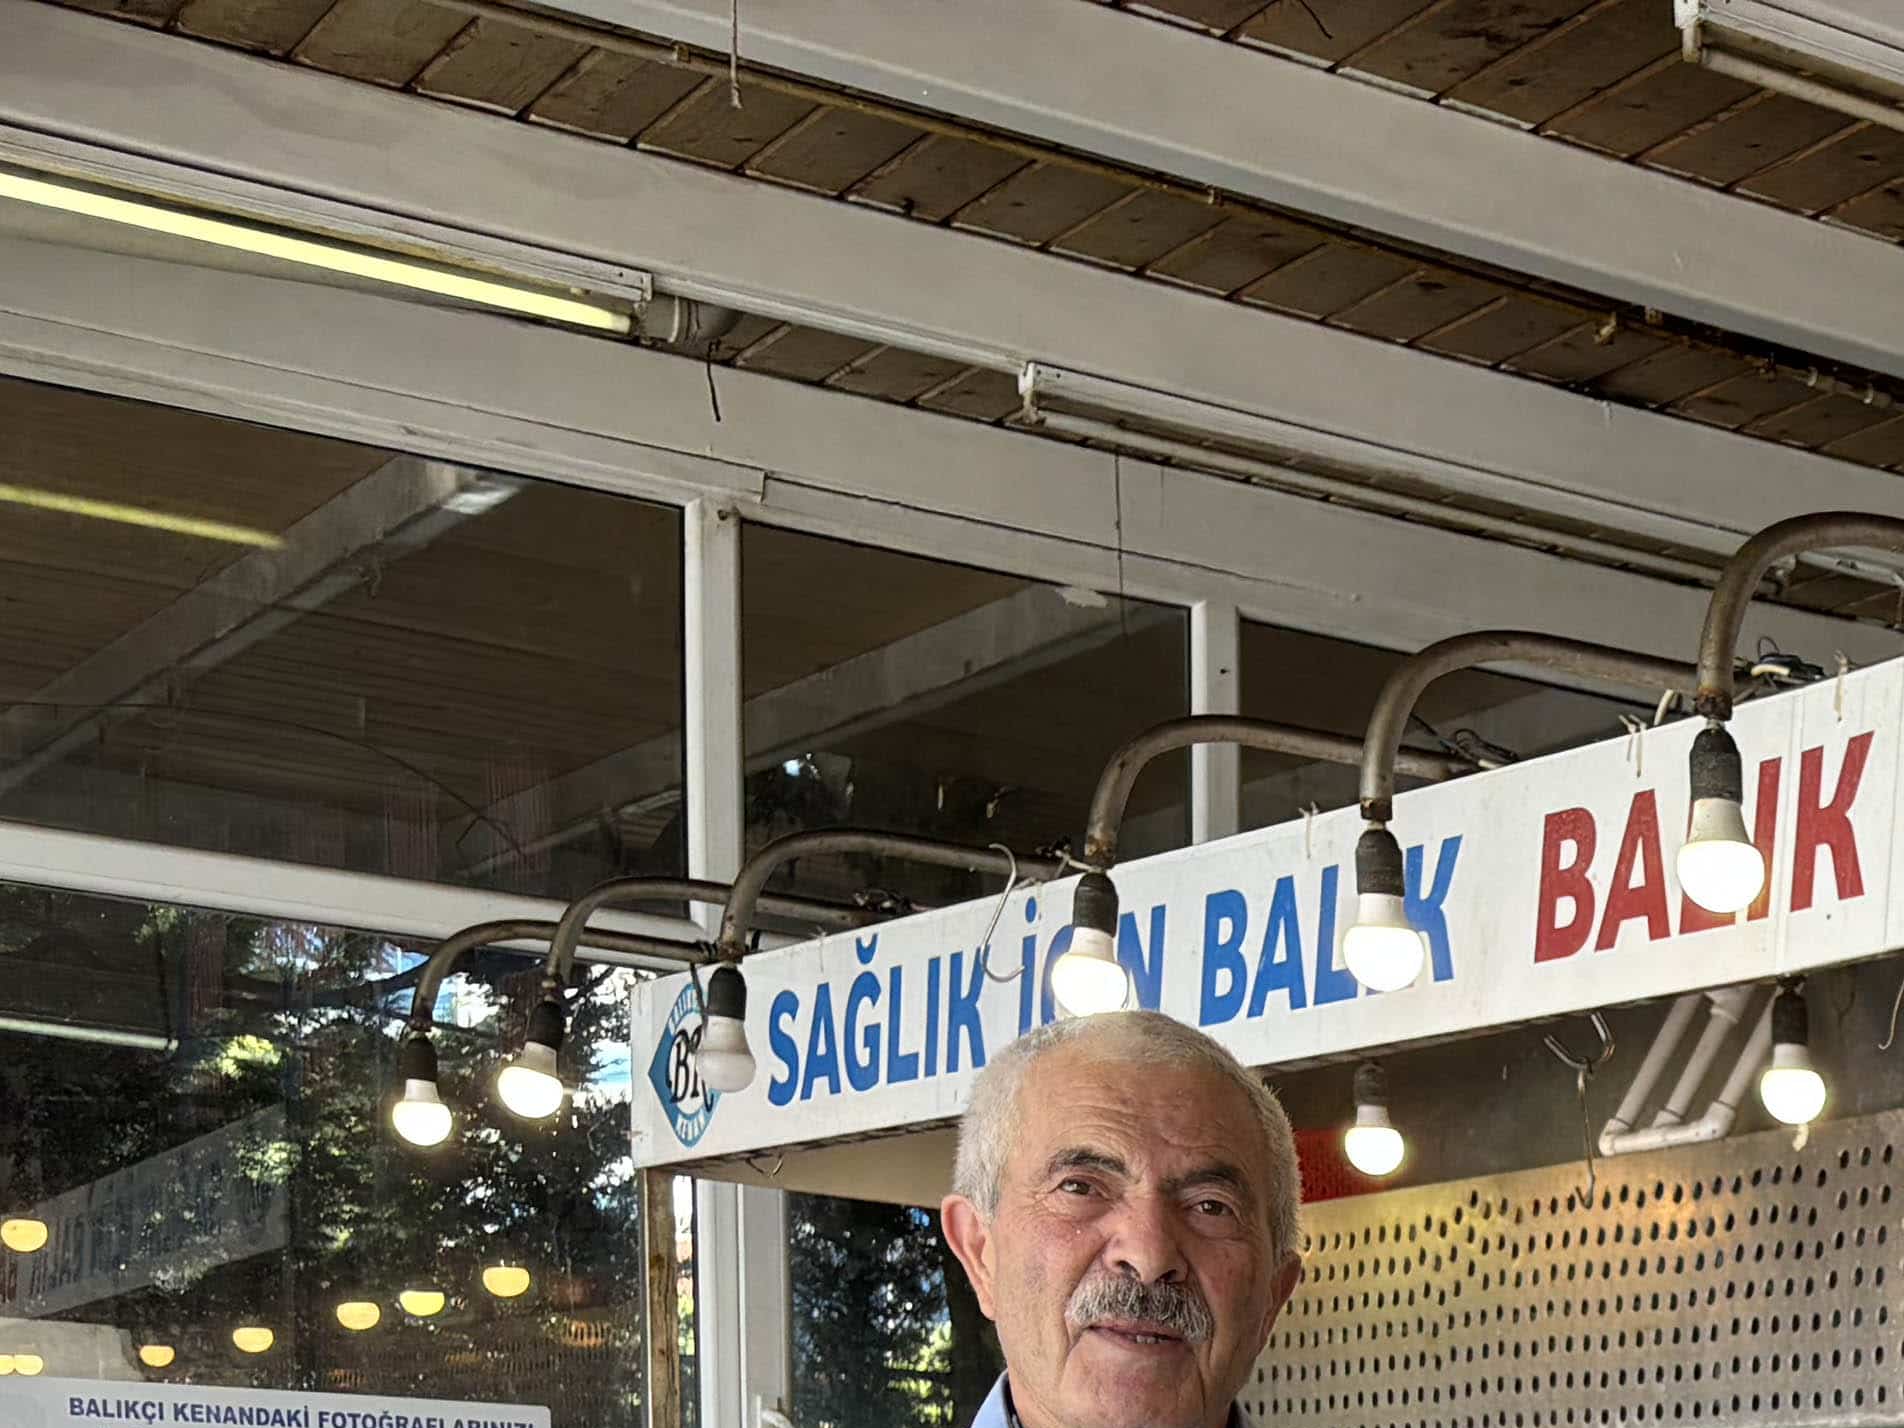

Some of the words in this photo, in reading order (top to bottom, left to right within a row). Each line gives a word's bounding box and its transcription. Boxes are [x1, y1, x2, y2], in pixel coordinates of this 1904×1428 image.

[767, 934, 990, 1107] SAĞLIK
[1018, 897, 1168, 1038] İN
[1199, 834, 1464, 1027] BALK
[68, 1396, 166, 1422] BALIKÇI
[173, 1401, 310, 1428] KENANDAKİ
